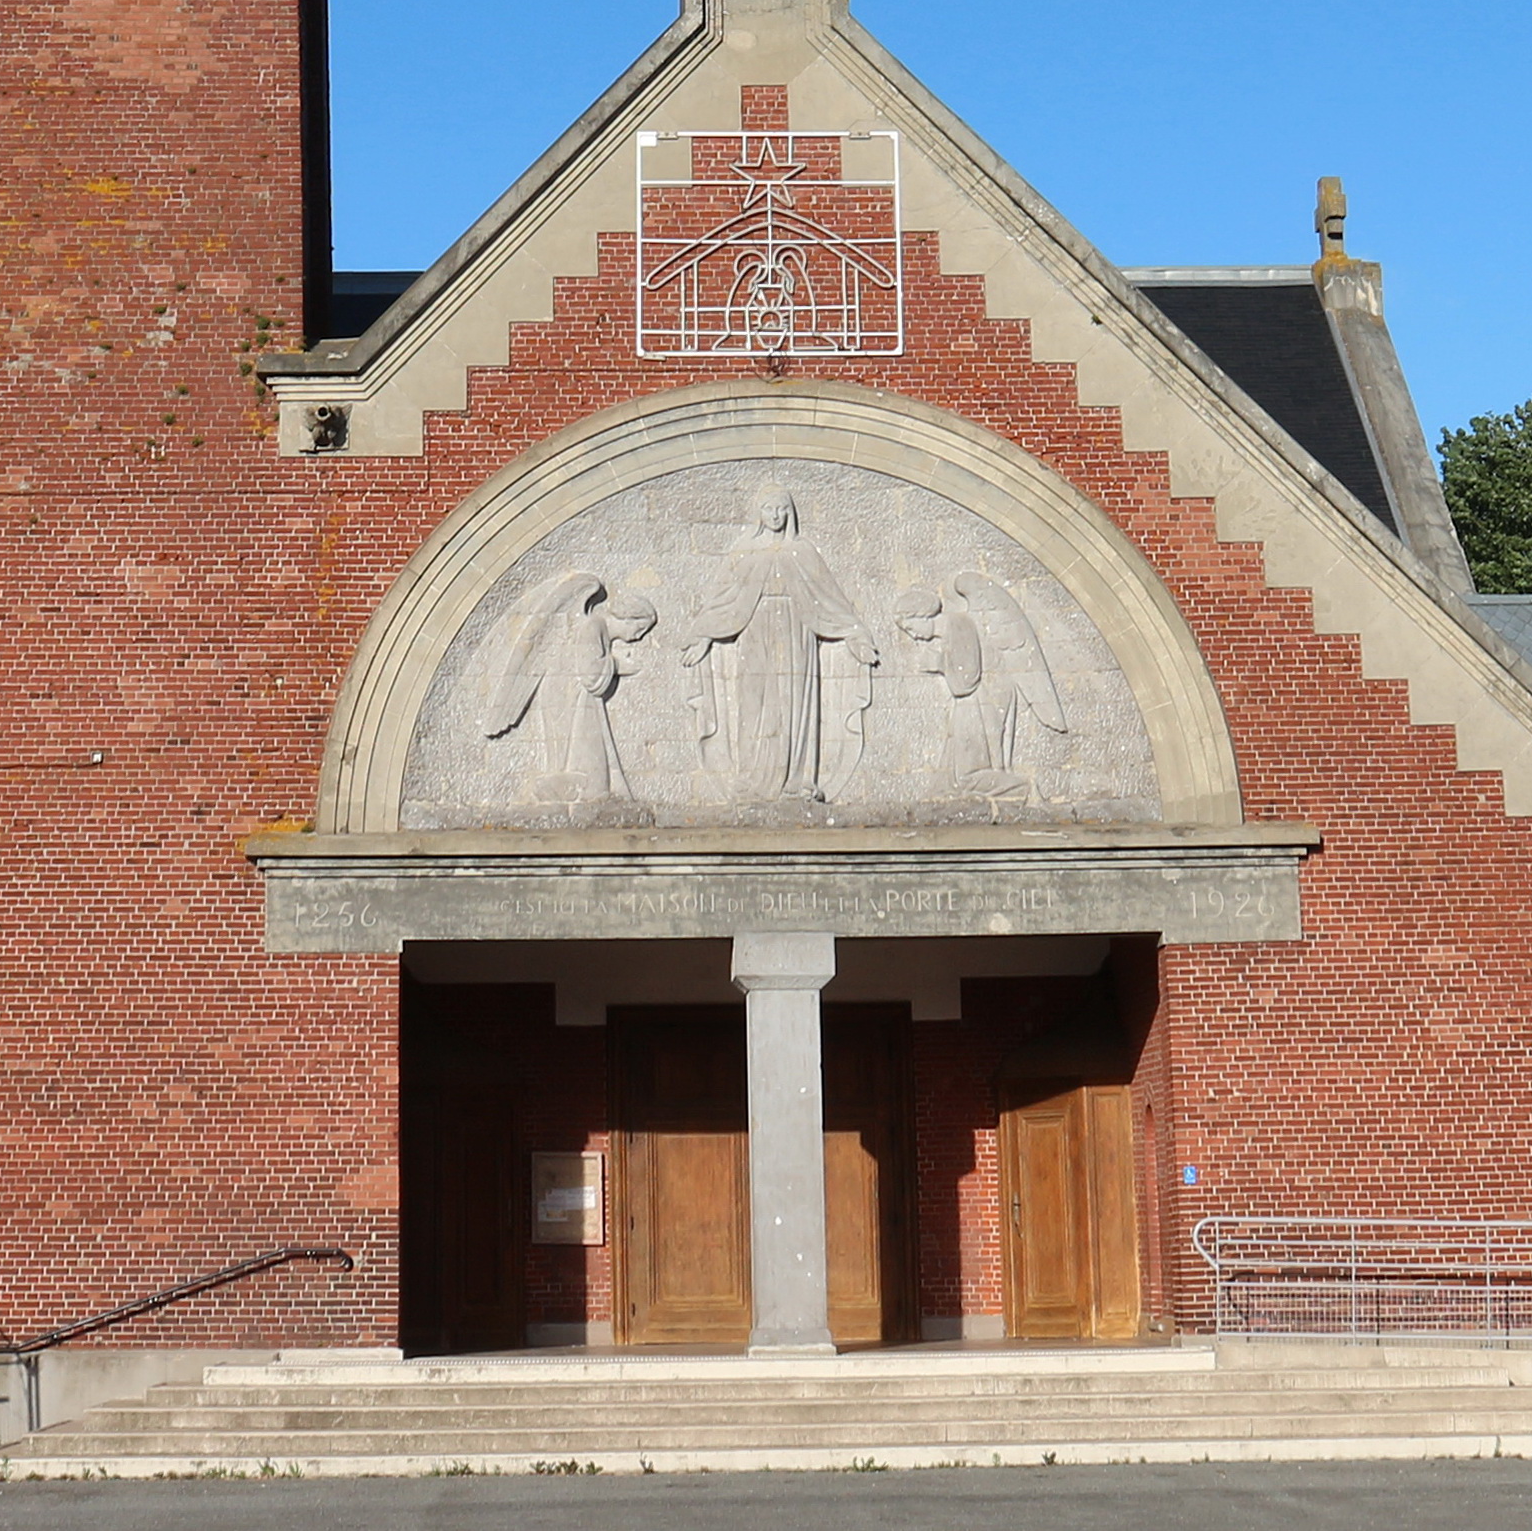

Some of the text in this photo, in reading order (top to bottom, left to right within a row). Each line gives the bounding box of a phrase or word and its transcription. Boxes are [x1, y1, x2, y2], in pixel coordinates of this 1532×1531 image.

[294, 900, 377, 928] 1256
[616, 892, 715, 913] MAISON
[886, 889, 961, 912] PORTE
[1190, 890, 1275, 919] 1926
